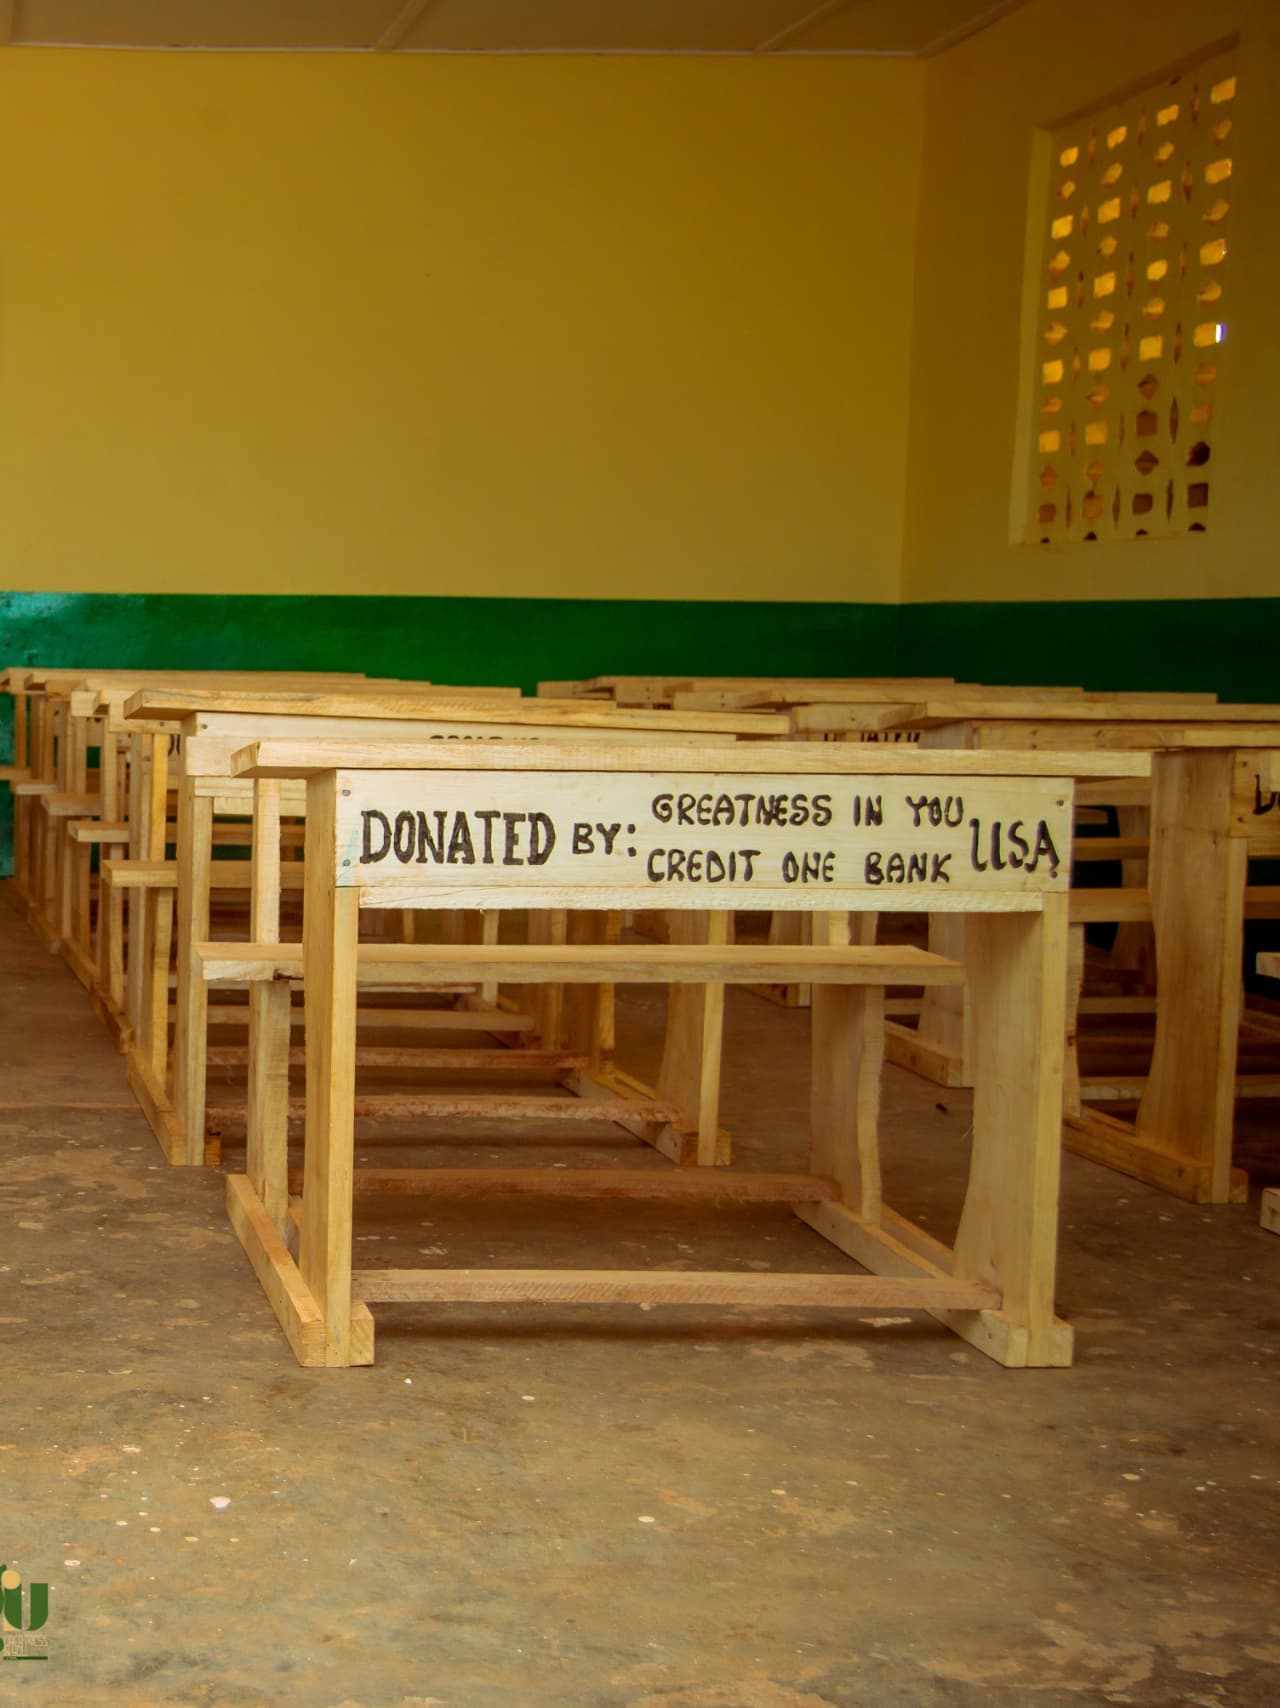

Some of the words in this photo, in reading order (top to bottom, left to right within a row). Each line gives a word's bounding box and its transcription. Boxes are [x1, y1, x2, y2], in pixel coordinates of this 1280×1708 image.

[652, 793, 832, 826] GREATNESS
[853, 795, 883, 827] IN
[905, 795, 964, 828] YOU
[360, 810, 556, 865] DONATED
[572, 823, 637, 857] BY:
[647, 848, 761, 884] CREDIT
[782, 851, 836, 884] ONE
[864, 851, 952, 886] BANK
